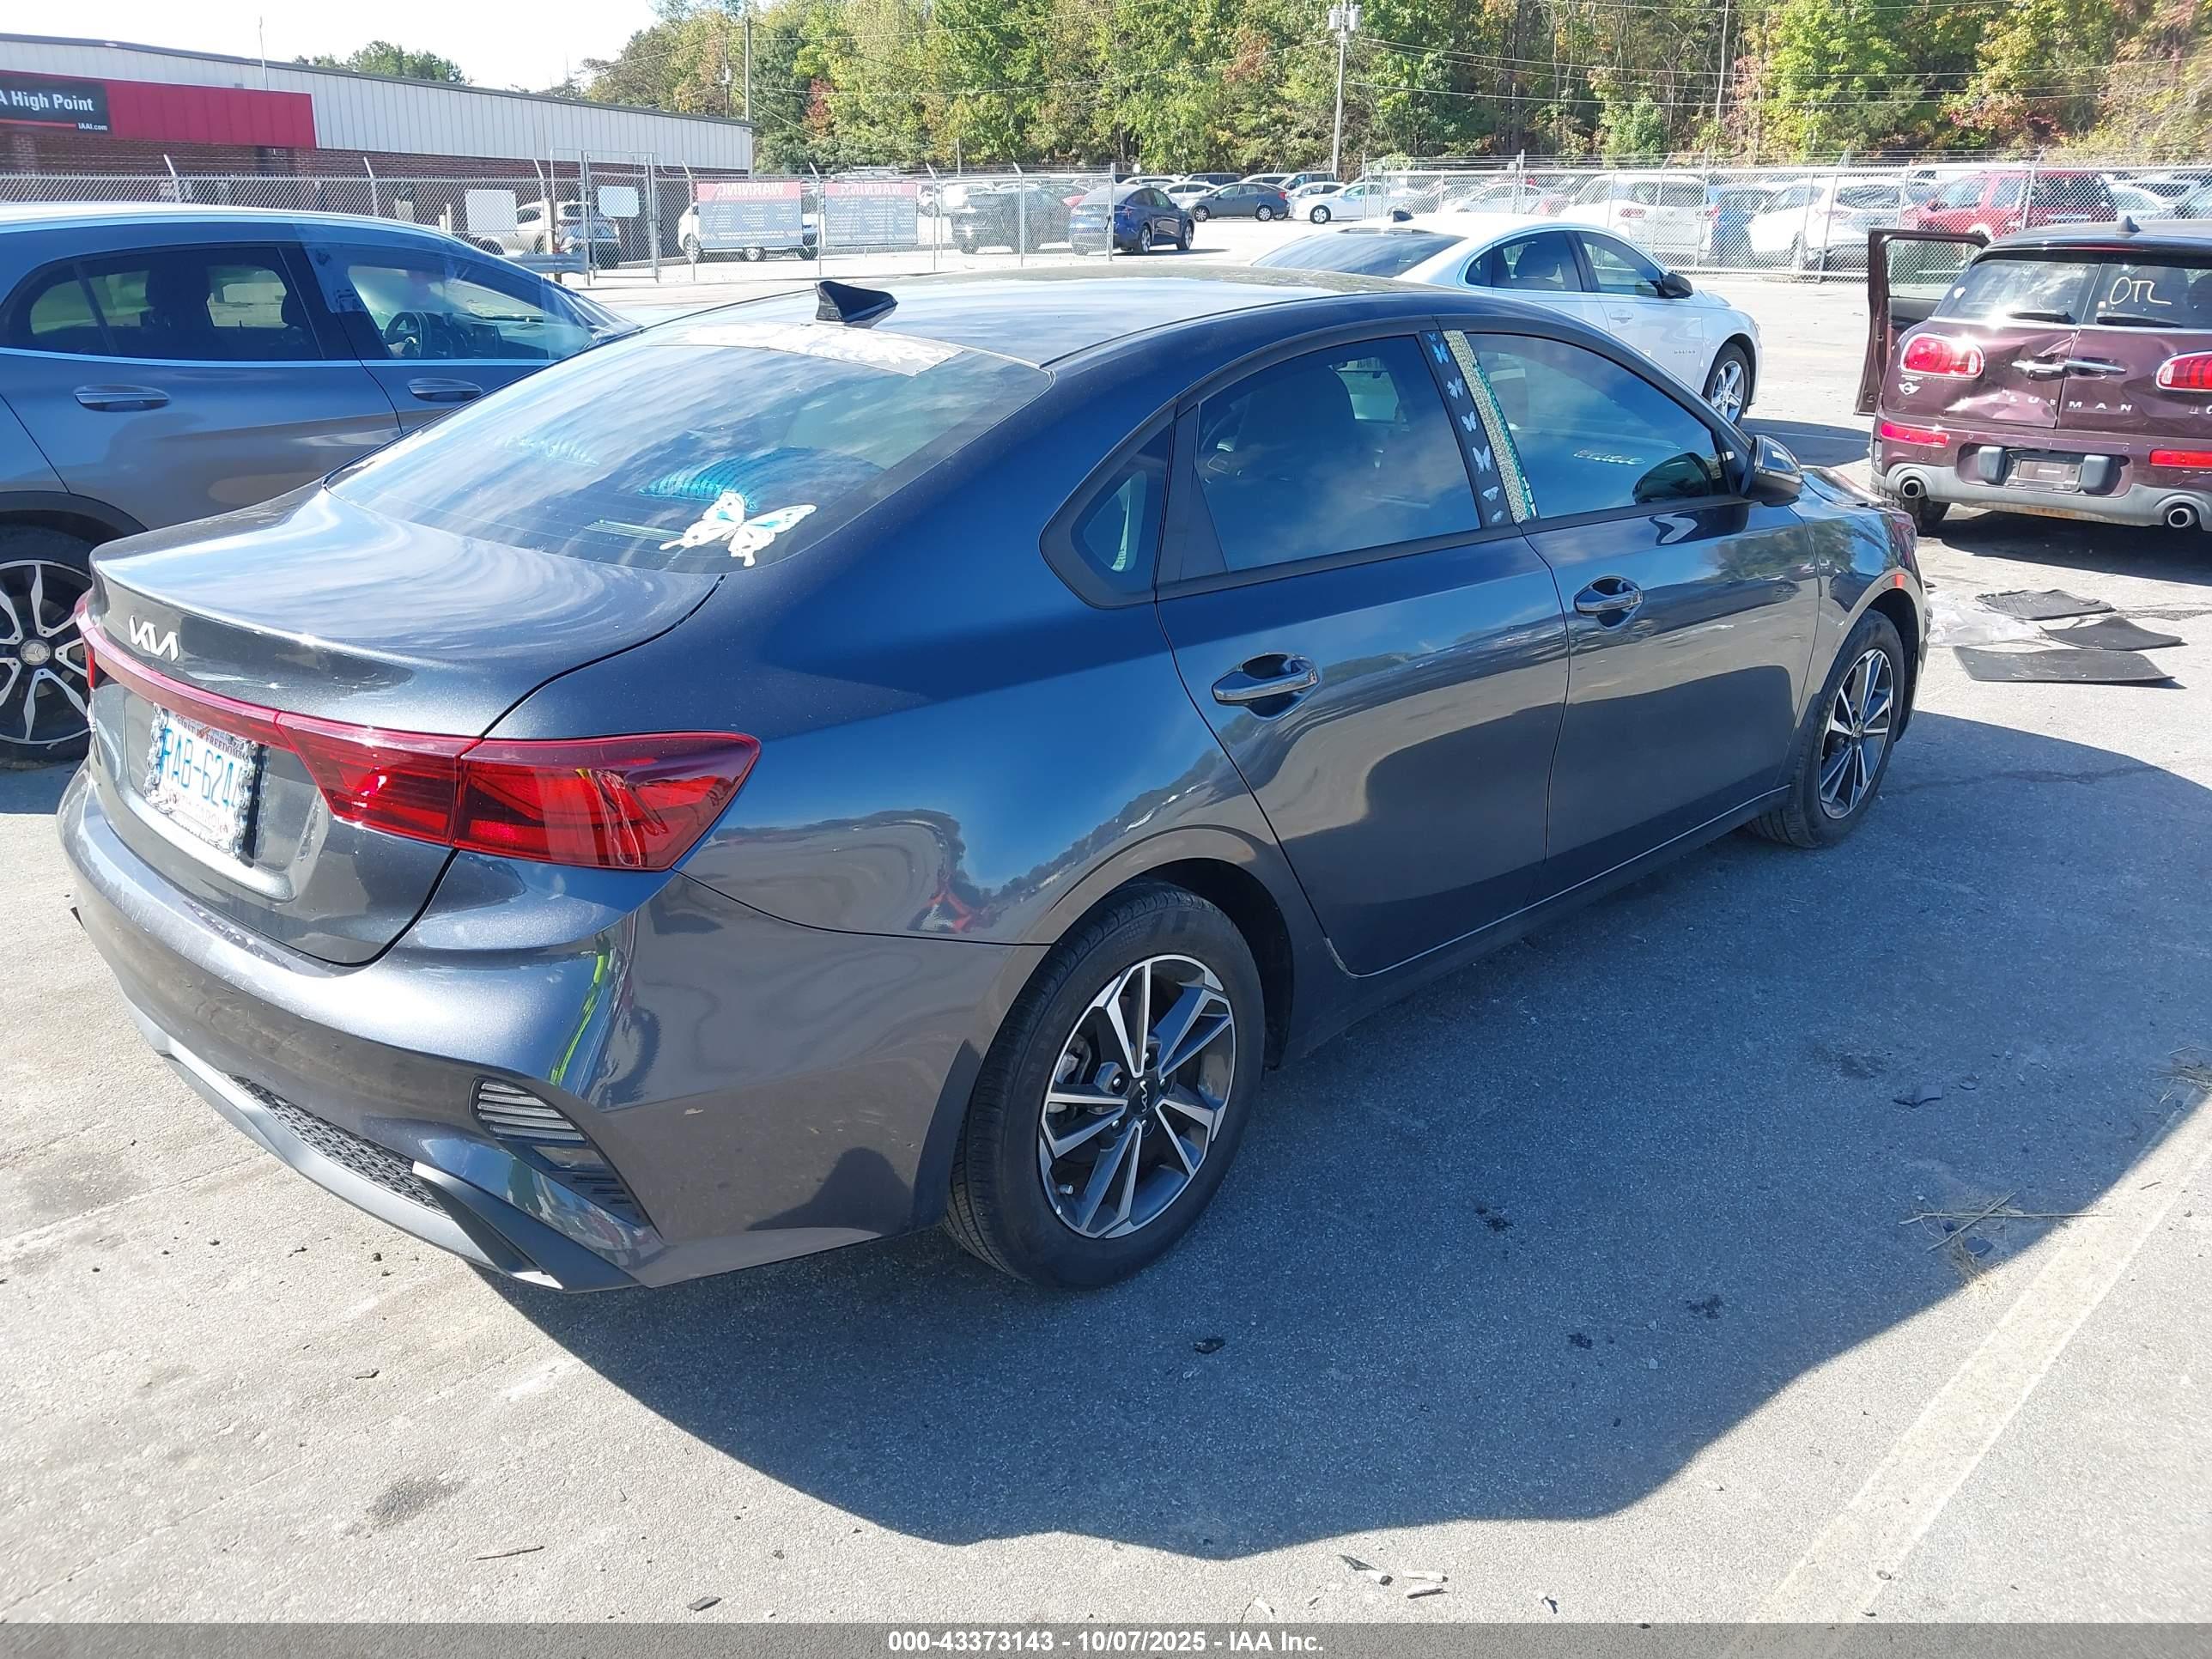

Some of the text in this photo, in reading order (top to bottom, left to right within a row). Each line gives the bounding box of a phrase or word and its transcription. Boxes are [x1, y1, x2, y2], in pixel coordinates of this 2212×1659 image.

[10, 90, 49, 112] High
[52, 93, 94, 112] Point
[128, 615, 180, 662] KIA
[160, 728, 241, 812] RAB-624
